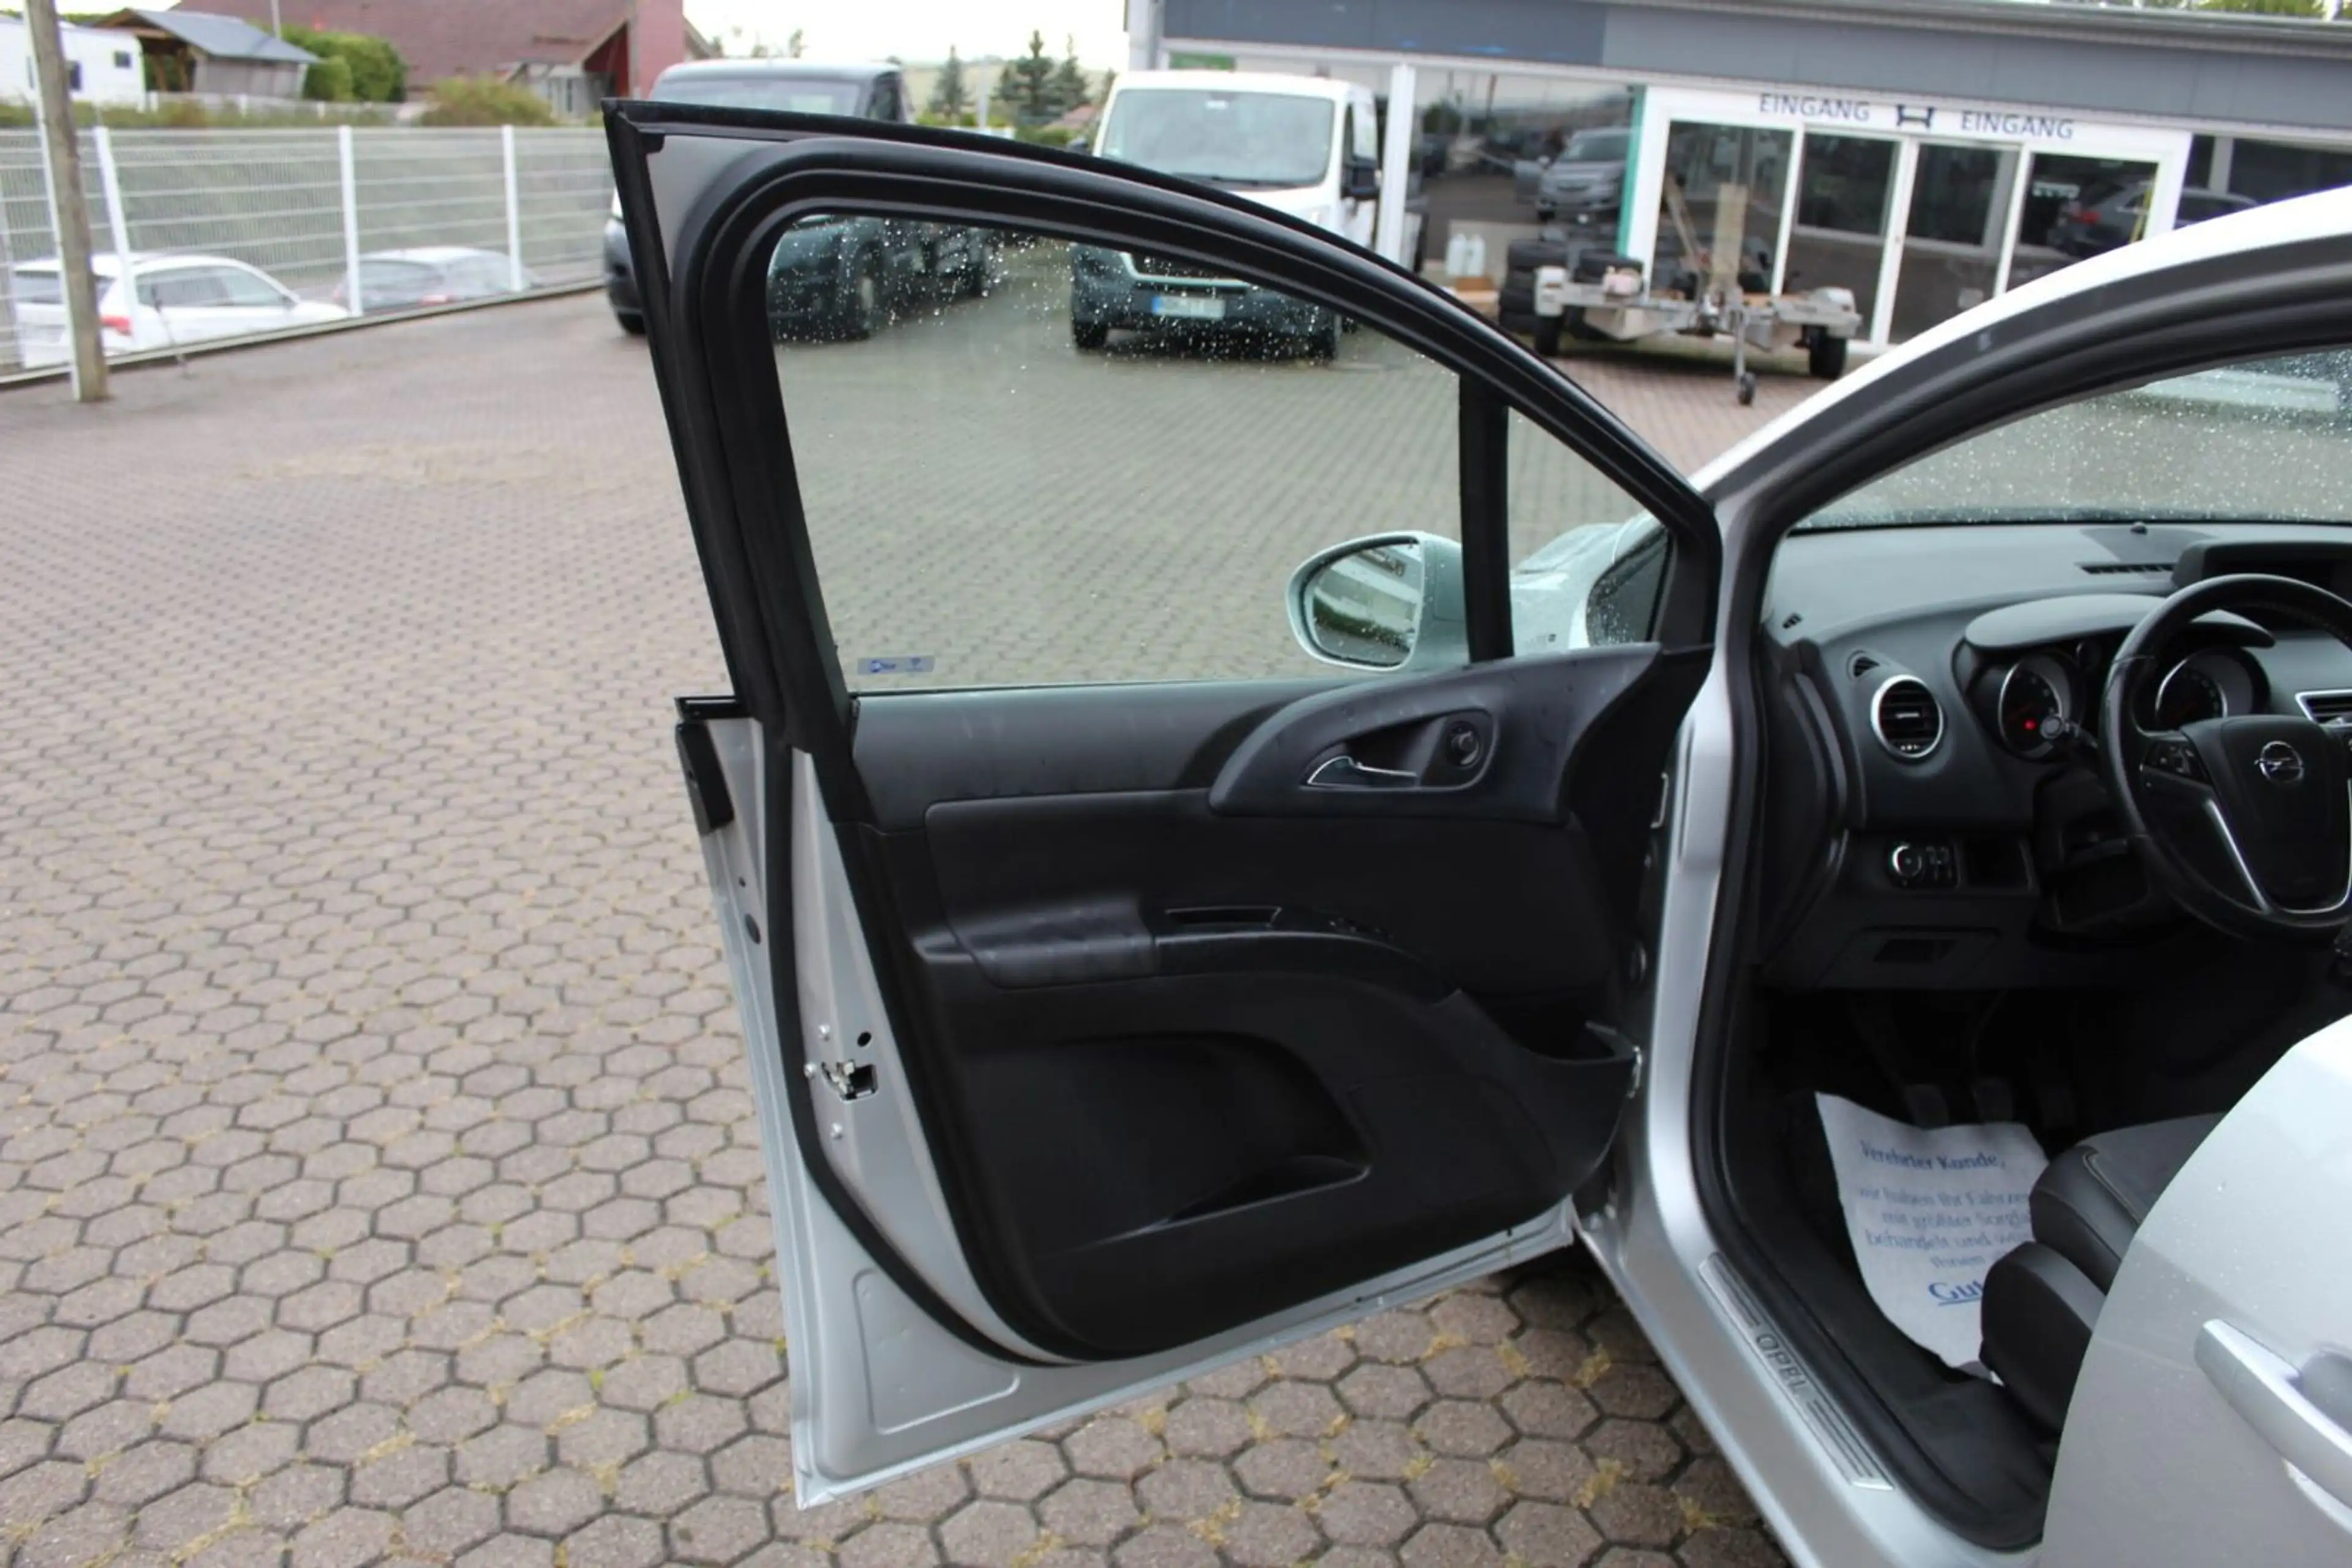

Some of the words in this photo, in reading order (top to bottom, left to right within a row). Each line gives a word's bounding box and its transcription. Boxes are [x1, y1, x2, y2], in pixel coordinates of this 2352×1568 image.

[1759, 92, 1871, 123] EINGANG
[1961, 110, 2075, 140] EINGANG
[1755, 1333, 1807, 1396] OPEL
